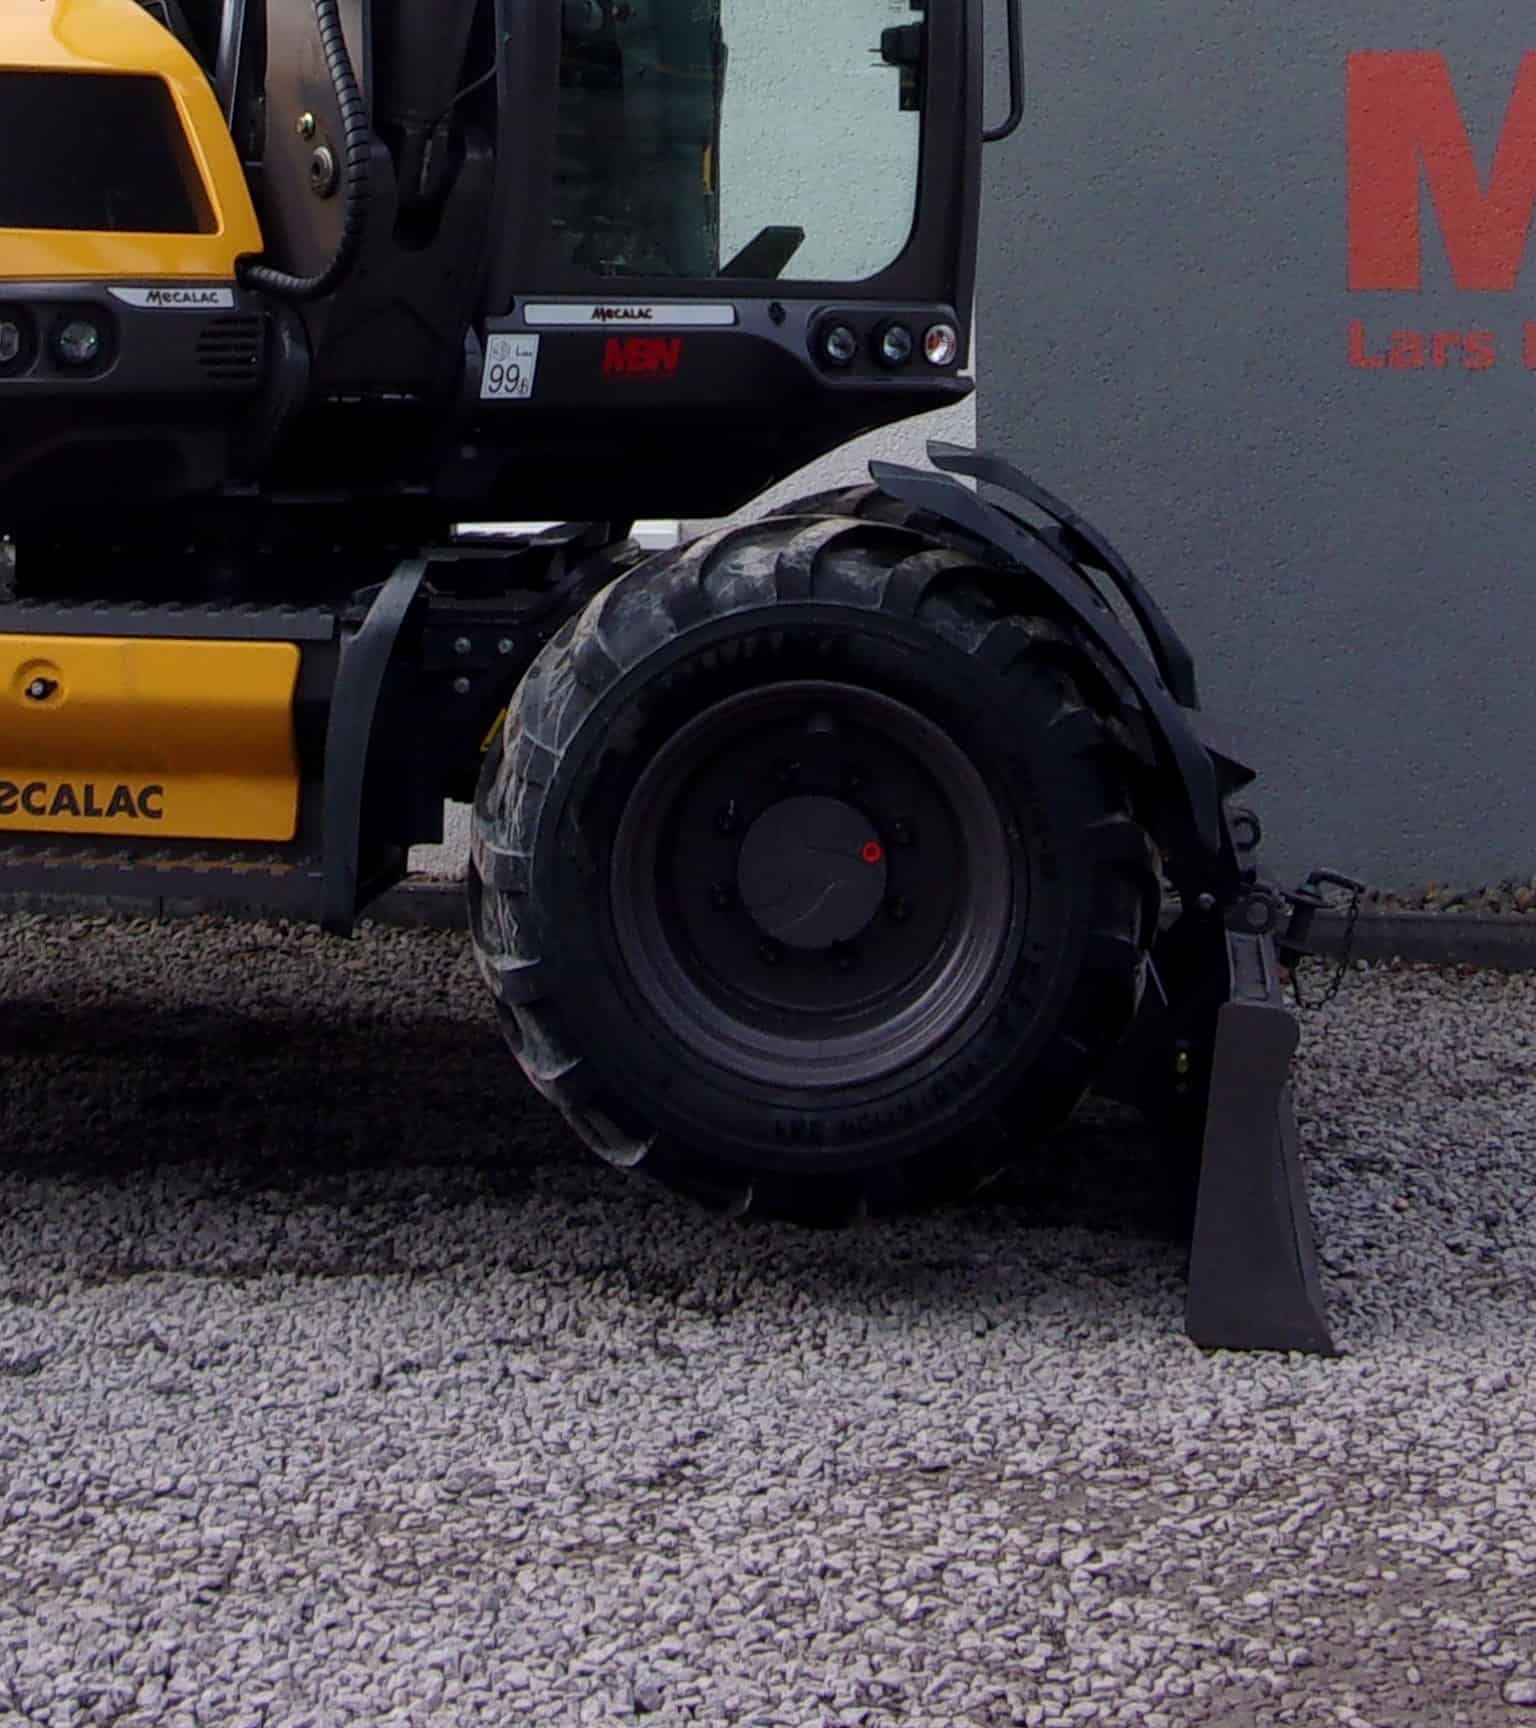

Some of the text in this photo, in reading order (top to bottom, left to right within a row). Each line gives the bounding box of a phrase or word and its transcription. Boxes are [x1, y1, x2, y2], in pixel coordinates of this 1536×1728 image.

[602, 336, 682, 372] MBN
[1347, 319, 1497, 370] Lars
[488, 363, 521, 394] 99
